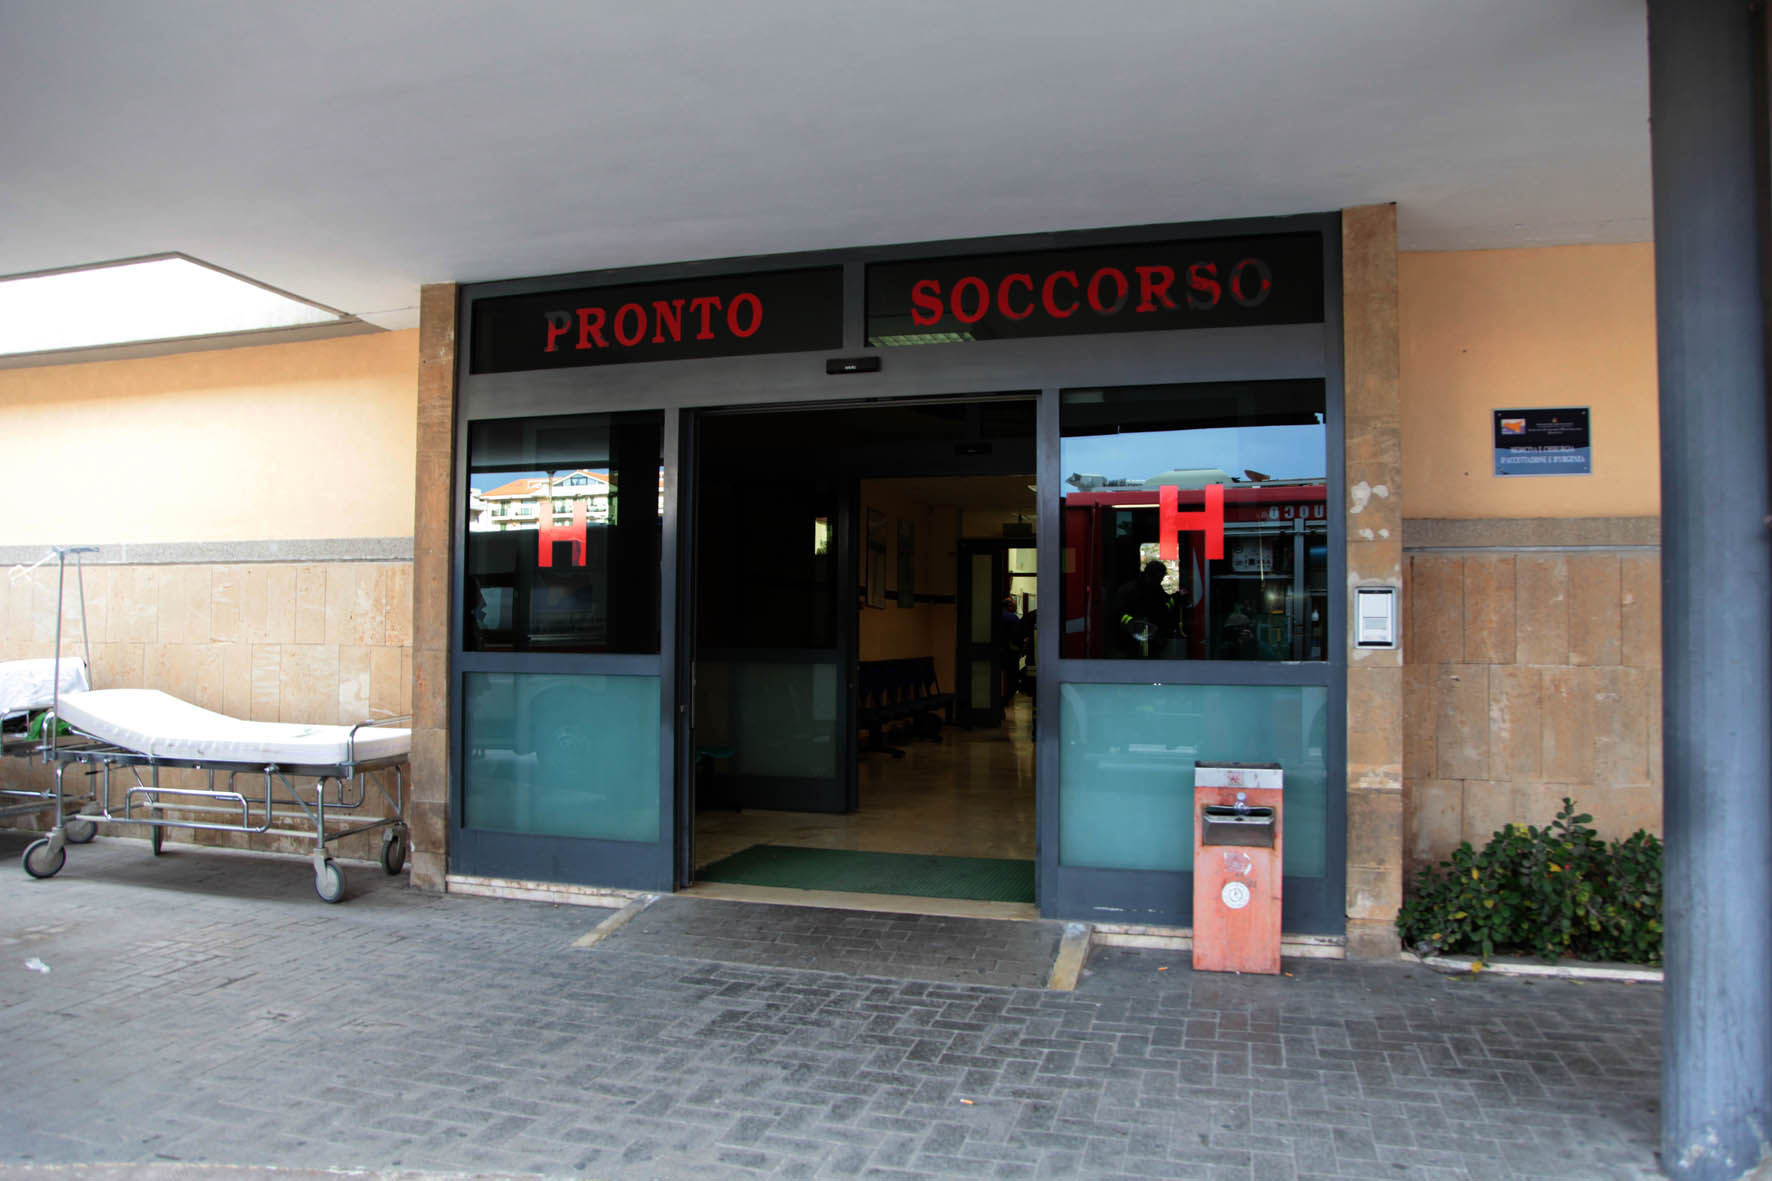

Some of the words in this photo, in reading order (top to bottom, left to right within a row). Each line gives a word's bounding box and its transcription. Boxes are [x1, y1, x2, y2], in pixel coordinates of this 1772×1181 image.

[544, 293, 763, 352] PRONTO
[911, 258, 1272, 326] SOCCORSO
[538, 502, 587, 567] H
[1160, 484, 1224, 560] H
